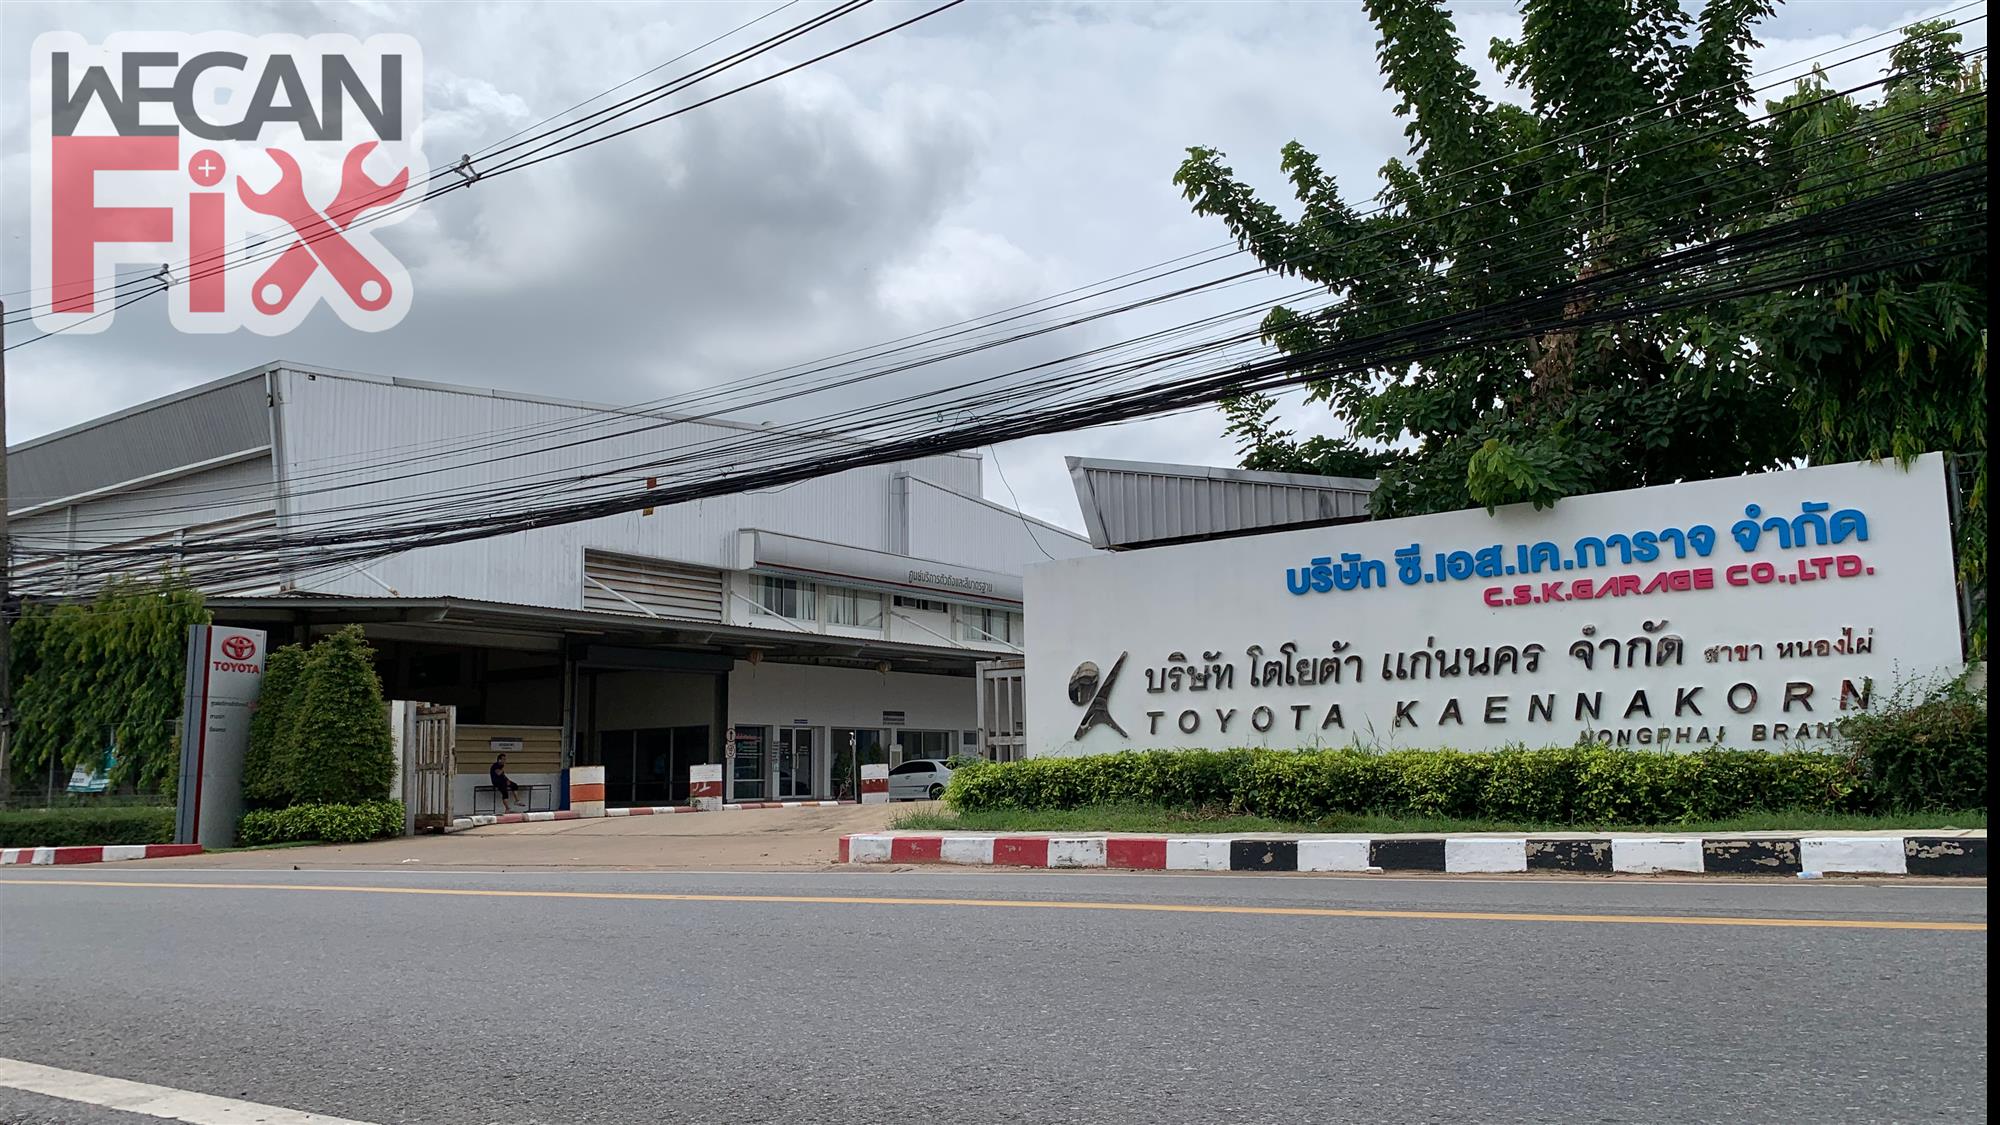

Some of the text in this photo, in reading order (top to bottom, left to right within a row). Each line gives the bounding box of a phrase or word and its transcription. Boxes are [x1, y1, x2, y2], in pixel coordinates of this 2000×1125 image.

[1286, 501, 1869, 596] บริษัท ซี.เอส.เค.การาจ จำกัด
[1483, 554, 1876, 607] C.S.K.GARAGE CO.,LTD.
[212, 661, 260, 675] TOYOTA
[1144, 619, 1875, 694] บริษัท โตโยต้า แก่นนคร จำกัด สาขา หนองไผ่
[1146, 677, 1873, 735] TOYOTA KAENNAKORN
